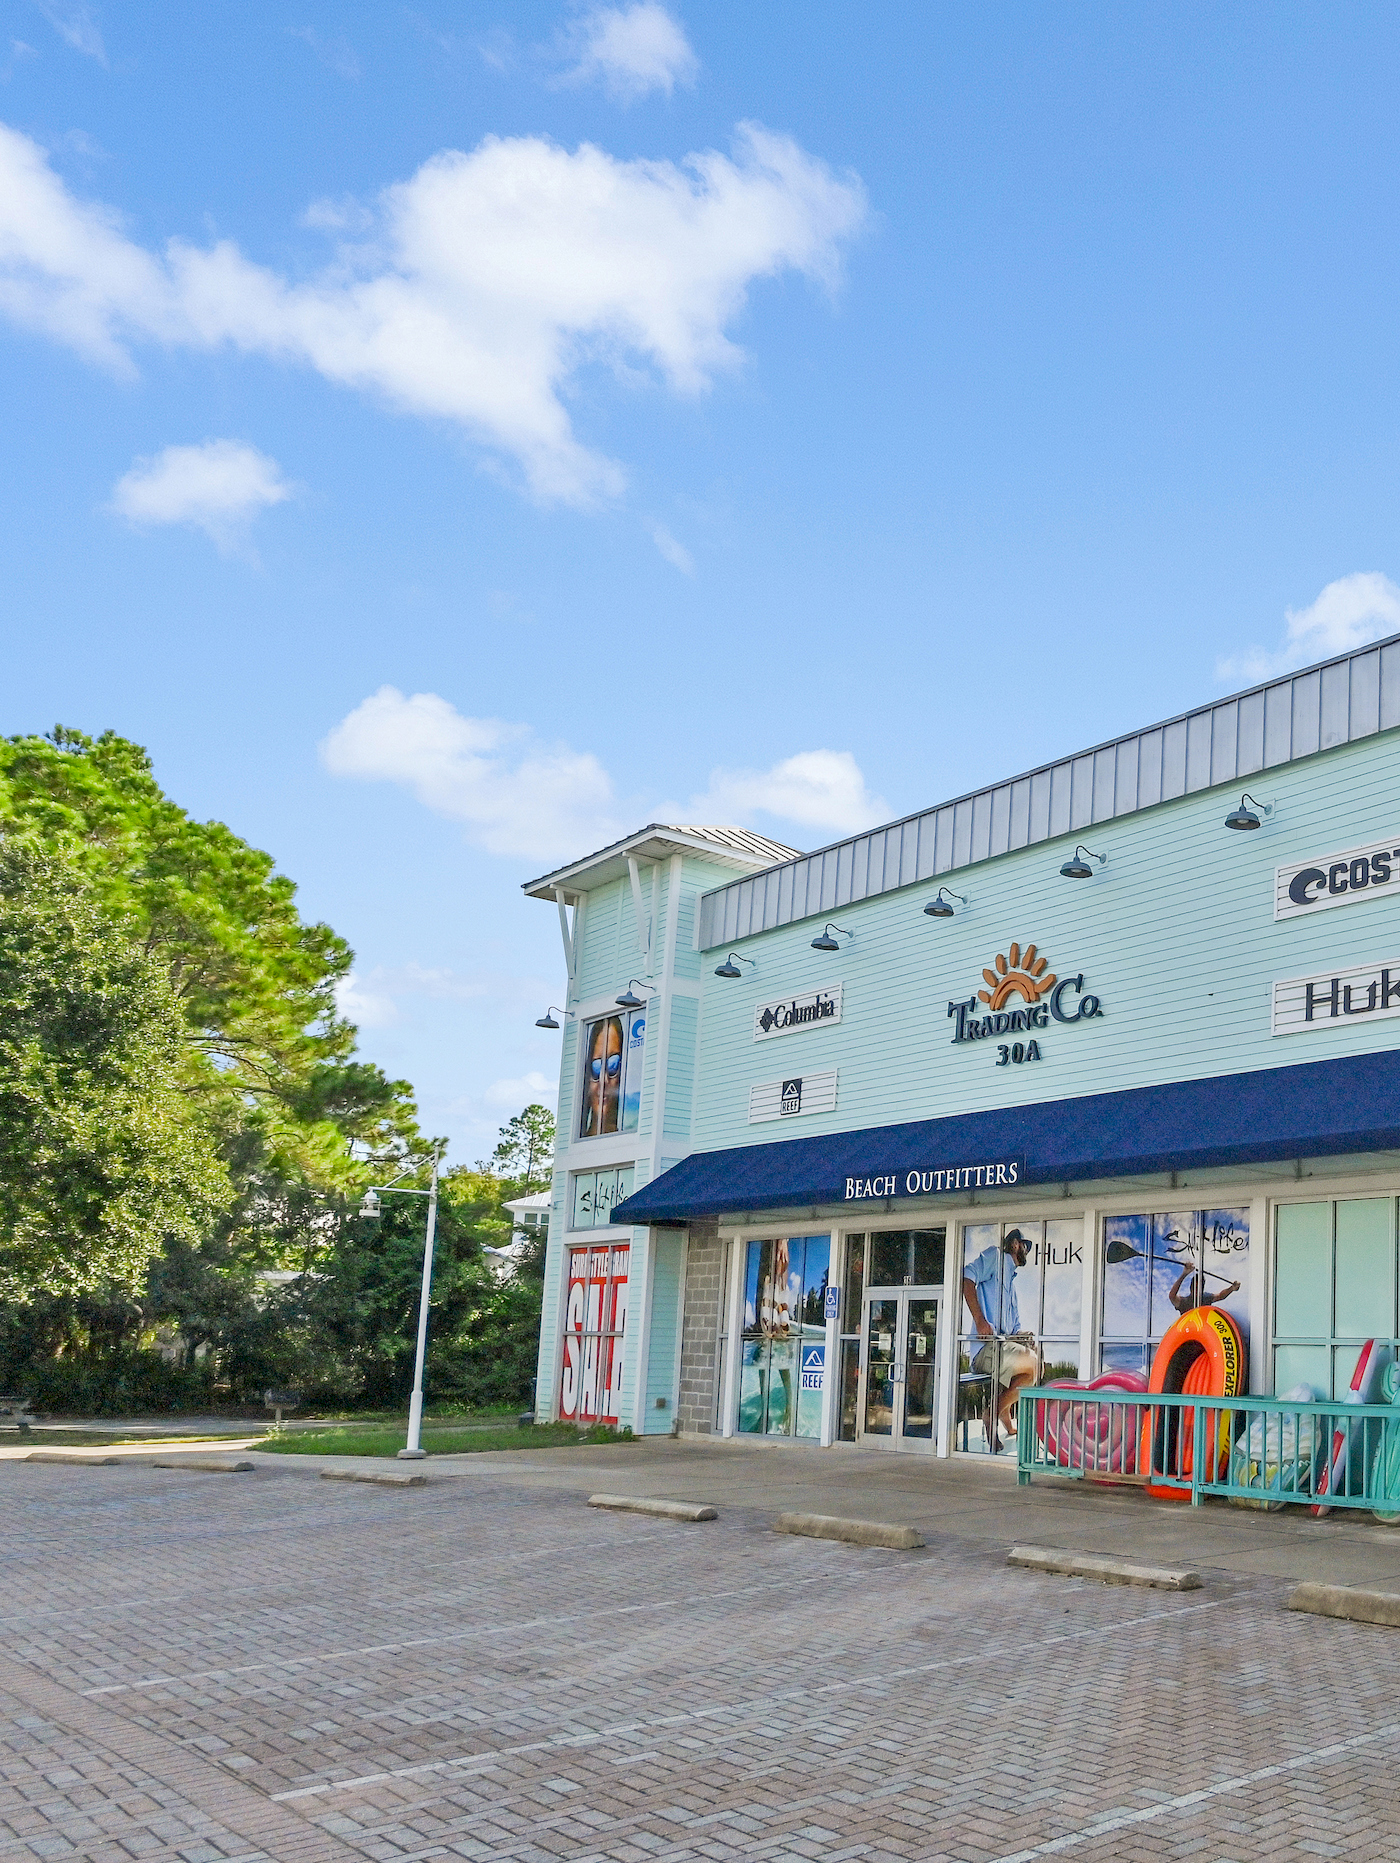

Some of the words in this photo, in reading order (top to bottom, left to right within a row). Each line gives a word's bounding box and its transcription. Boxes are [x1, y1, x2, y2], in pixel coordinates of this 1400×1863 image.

[774, 993, 835, 1028] Columbia
[629, 1038, 645, 1048] COST
[995, 1039, 1042, 1066] 30A
[781, 1100, 799, 1113] REEF
[1034, 1241, 1083, 1266] Huk
[1214, 1320, 1228, 1334] 300
[1222, 1336, 1235, 1397] EXPLORER
[802, 1374, 824, 1389] REEF
